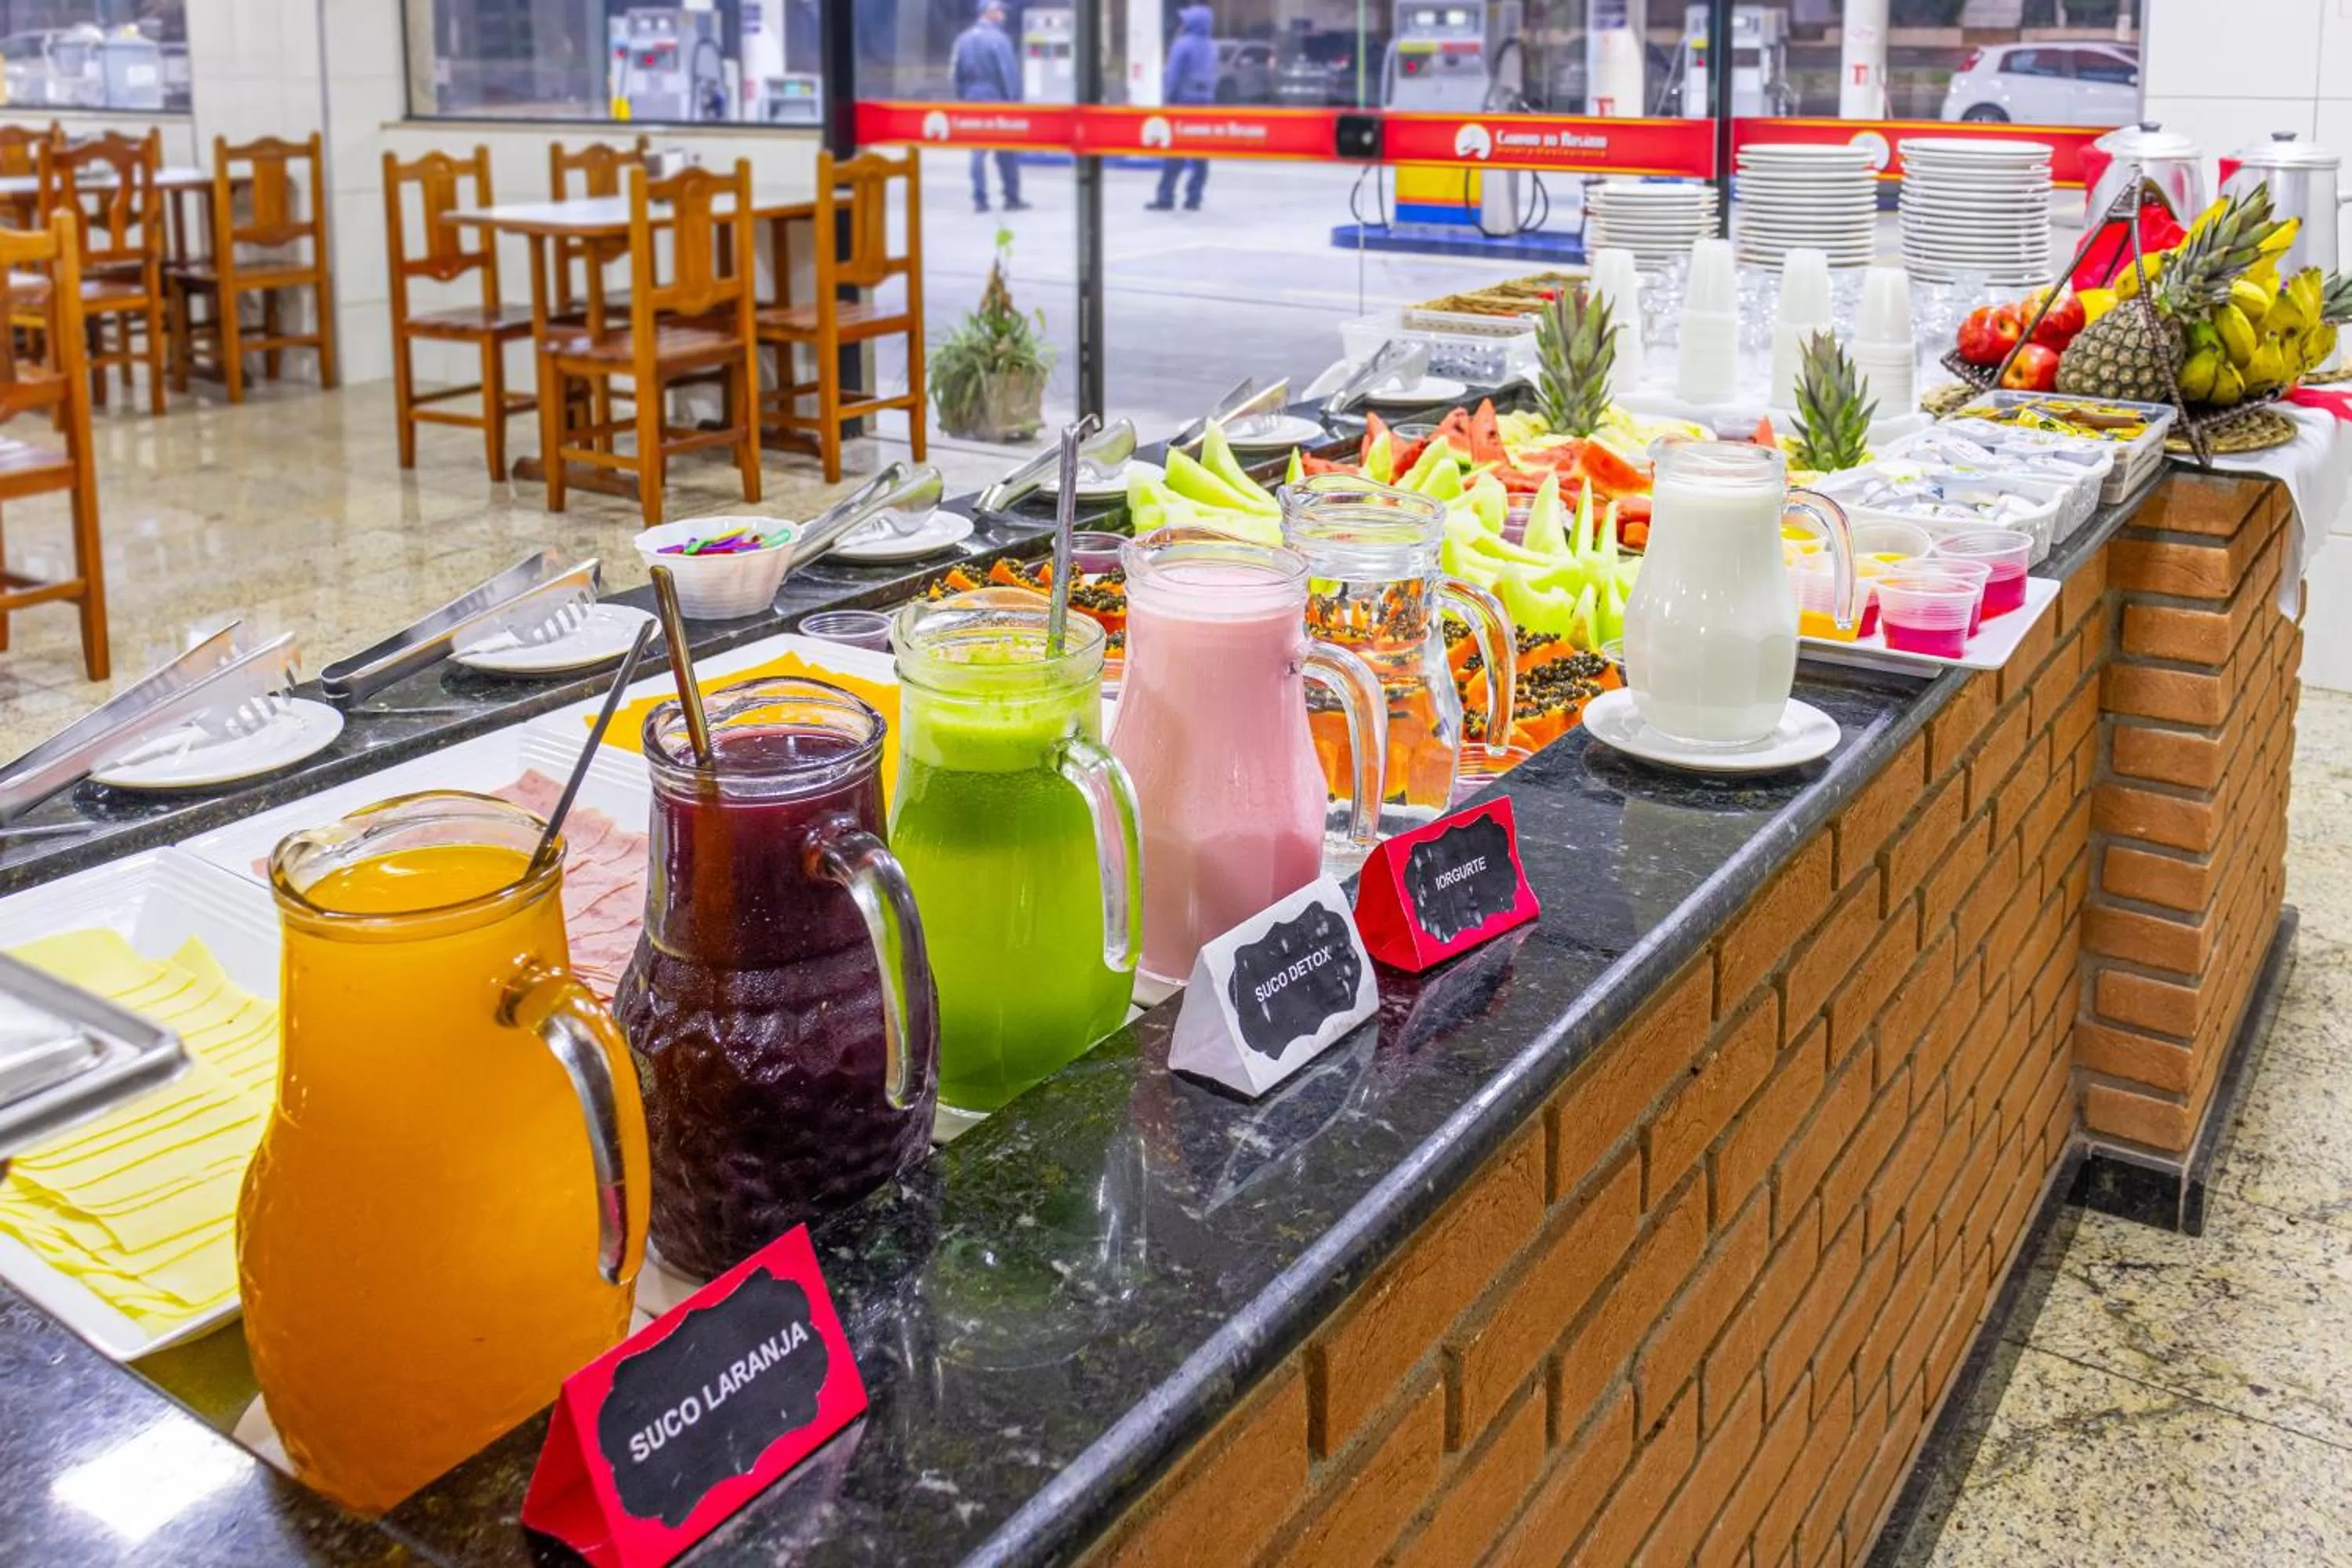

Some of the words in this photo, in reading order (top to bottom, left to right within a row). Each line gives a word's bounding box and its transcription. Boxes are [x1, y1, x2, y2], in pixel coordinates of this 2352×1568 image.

[1436, 855, 1487, 891] IORGURTE
[1255, 971, 1288, 1003] SUCO
[1288, 946, 1333, 982] DETOX
[629, 1396, 702, 1462] SUCO
[702, 1321, 809, 1411] LARANJA
